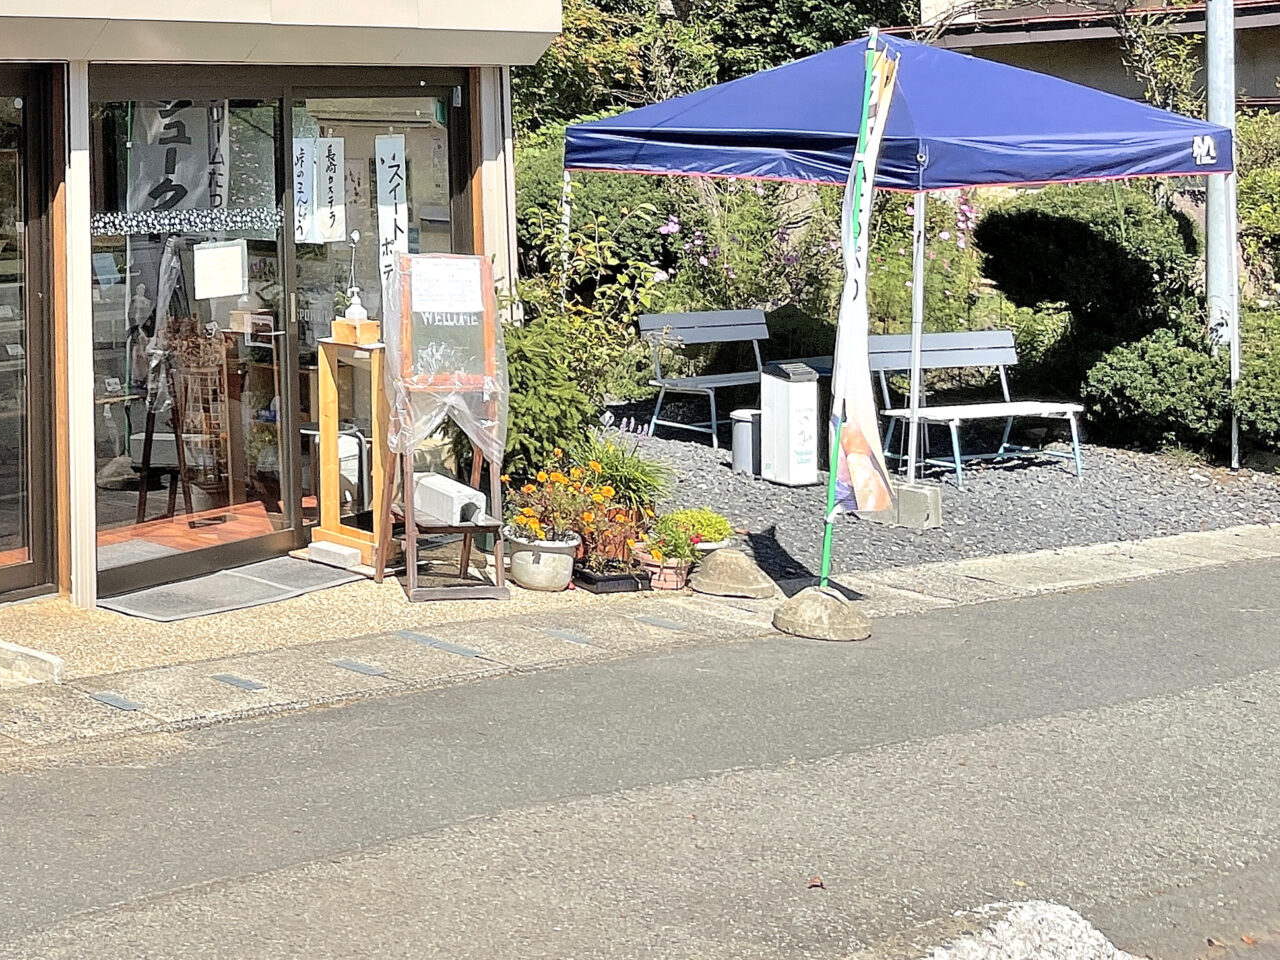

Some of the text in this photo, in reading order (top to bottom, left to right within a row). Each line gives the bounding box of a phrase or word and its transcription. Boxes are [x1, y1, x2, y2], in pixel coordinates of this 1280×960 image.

[325, 144, 338, 228] 長崎カステラ
